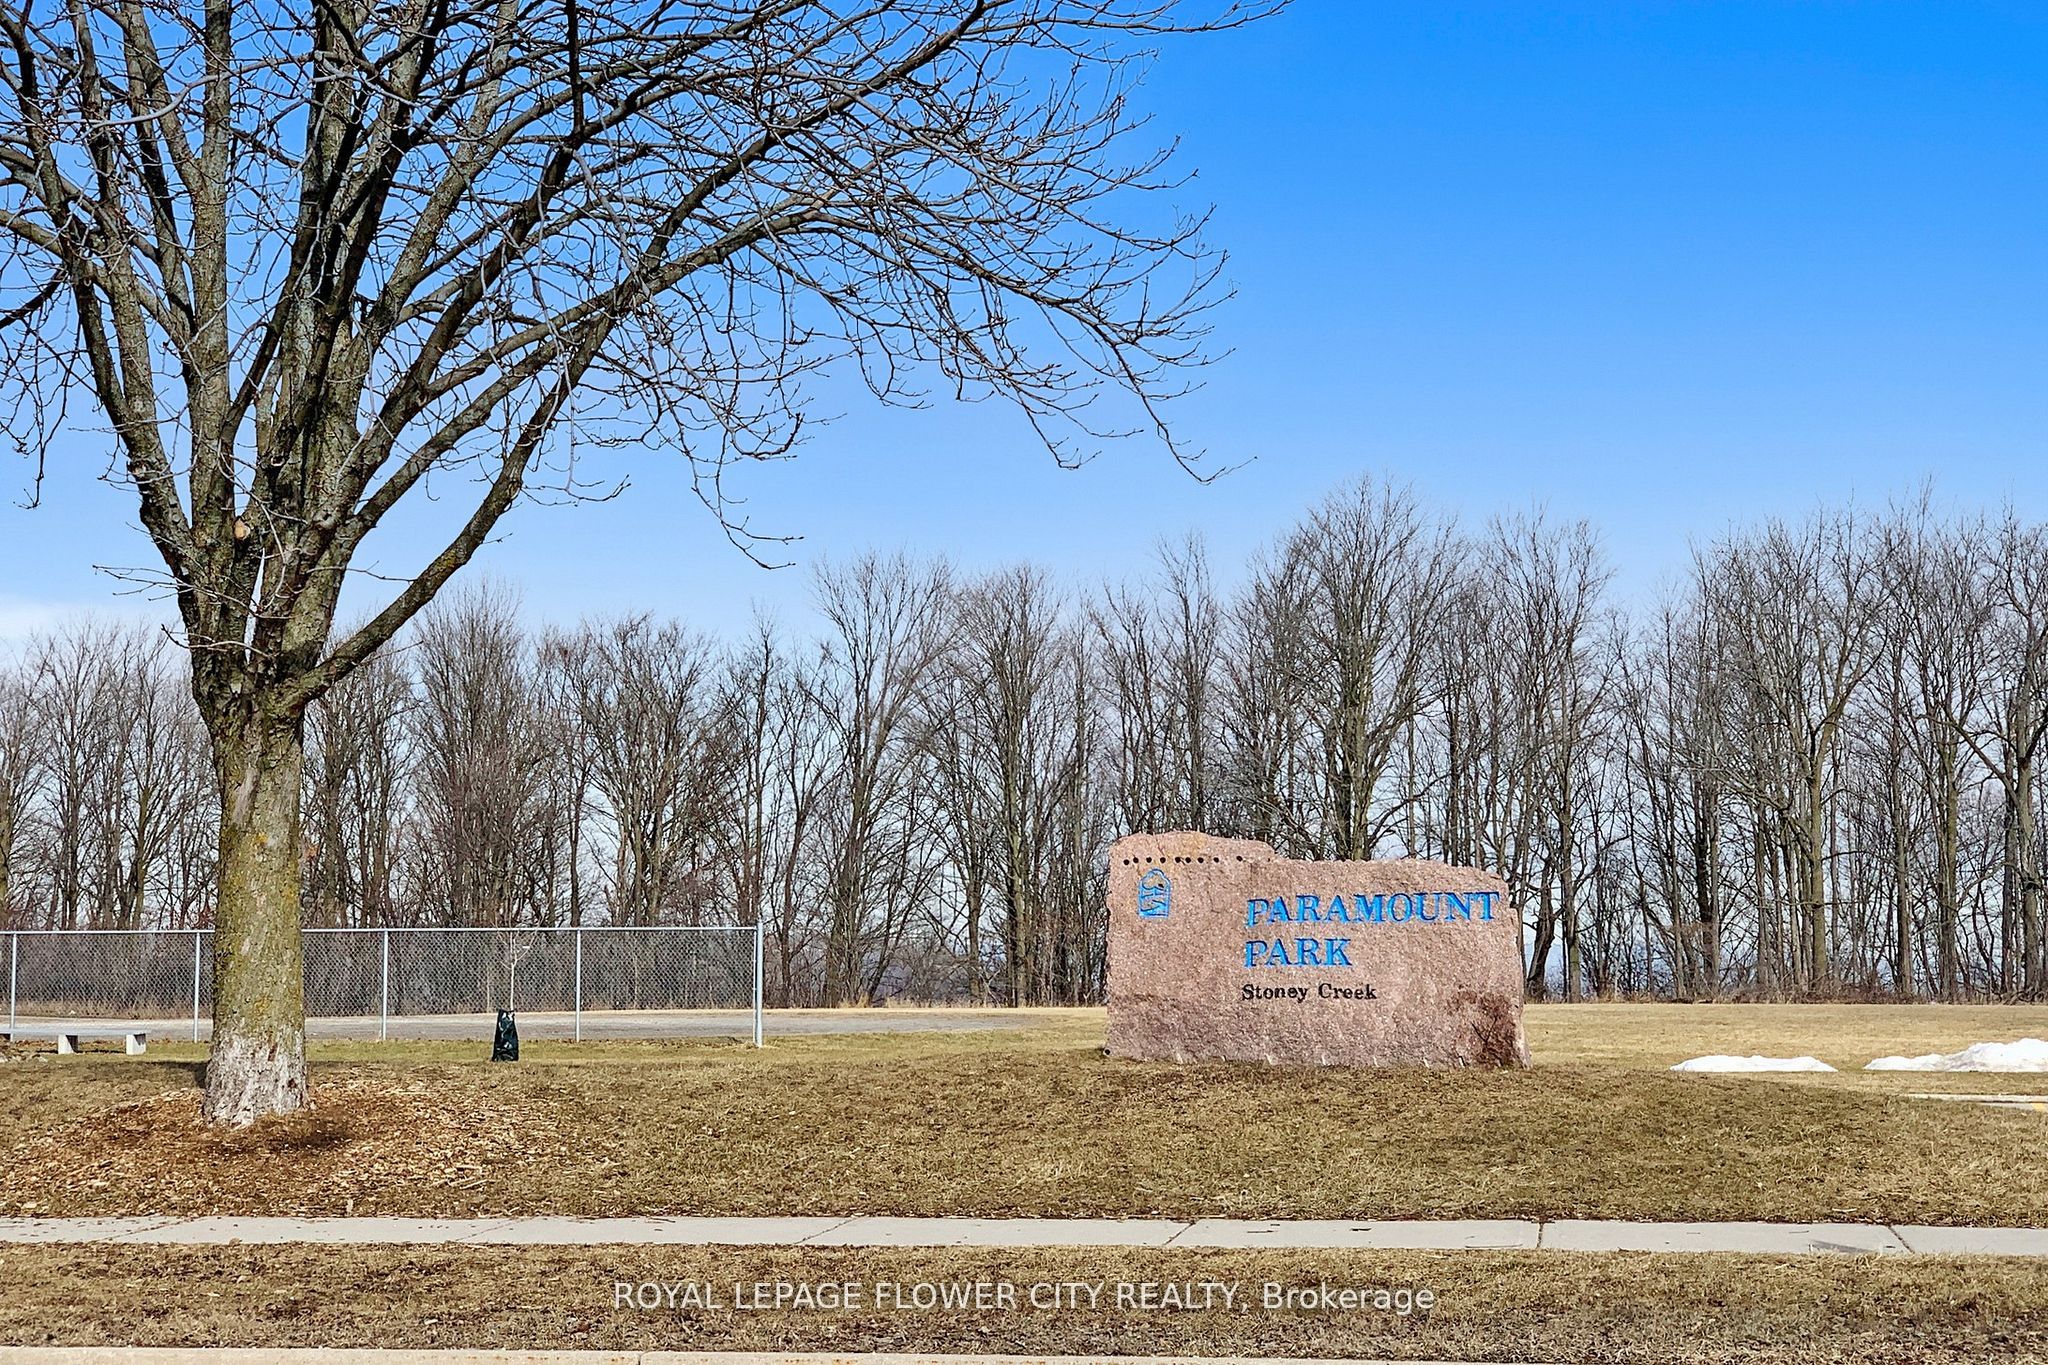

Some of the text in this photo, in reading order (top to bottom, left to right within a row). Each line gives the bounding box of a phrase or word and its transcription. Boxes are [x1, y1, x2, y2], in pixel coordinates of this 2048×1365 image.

[1246, 891, 1500, 928] PARAMOUNT
[1244, 937, 1353, 968] PARK
[1241, 983, 1378, 1004] Stoney Creek
